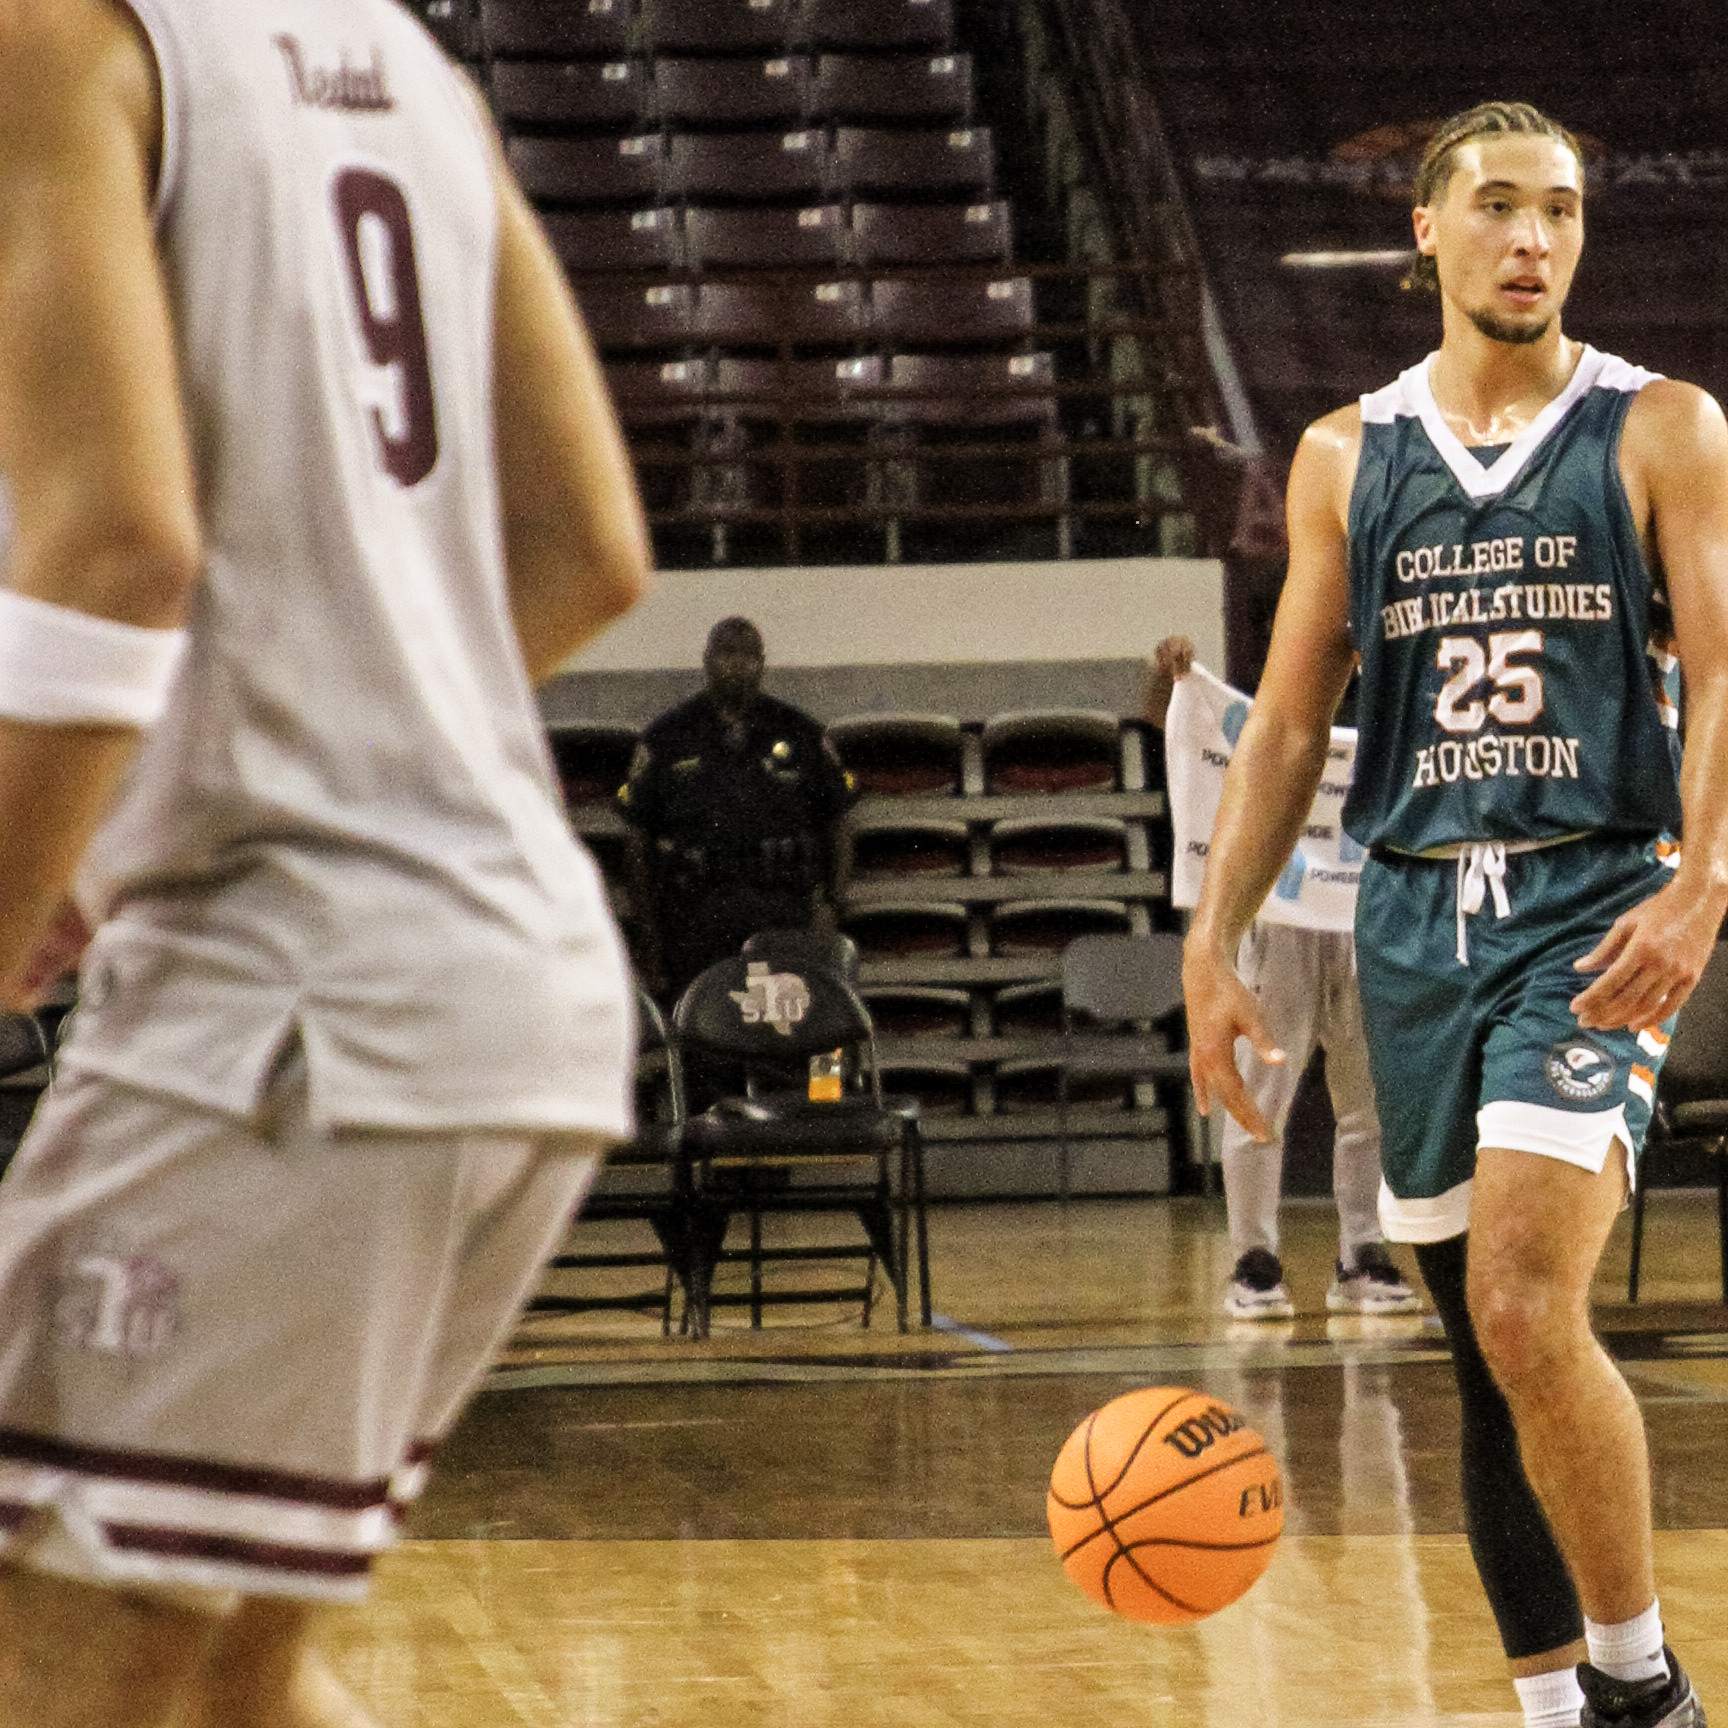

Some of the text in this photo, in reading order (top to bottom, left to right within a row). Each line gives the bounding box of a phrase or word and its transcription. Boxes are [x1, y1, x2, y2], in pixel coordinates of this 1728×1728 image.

[330, 166, 440, 488] 9
[1396, 536, 1578, 582] COLLEGE OF
[1490, 584, 1612, 621] STUDIES
[1433, 630, 1544, 733] 25
[1412, 735, 1580, 788] HOUSTON
